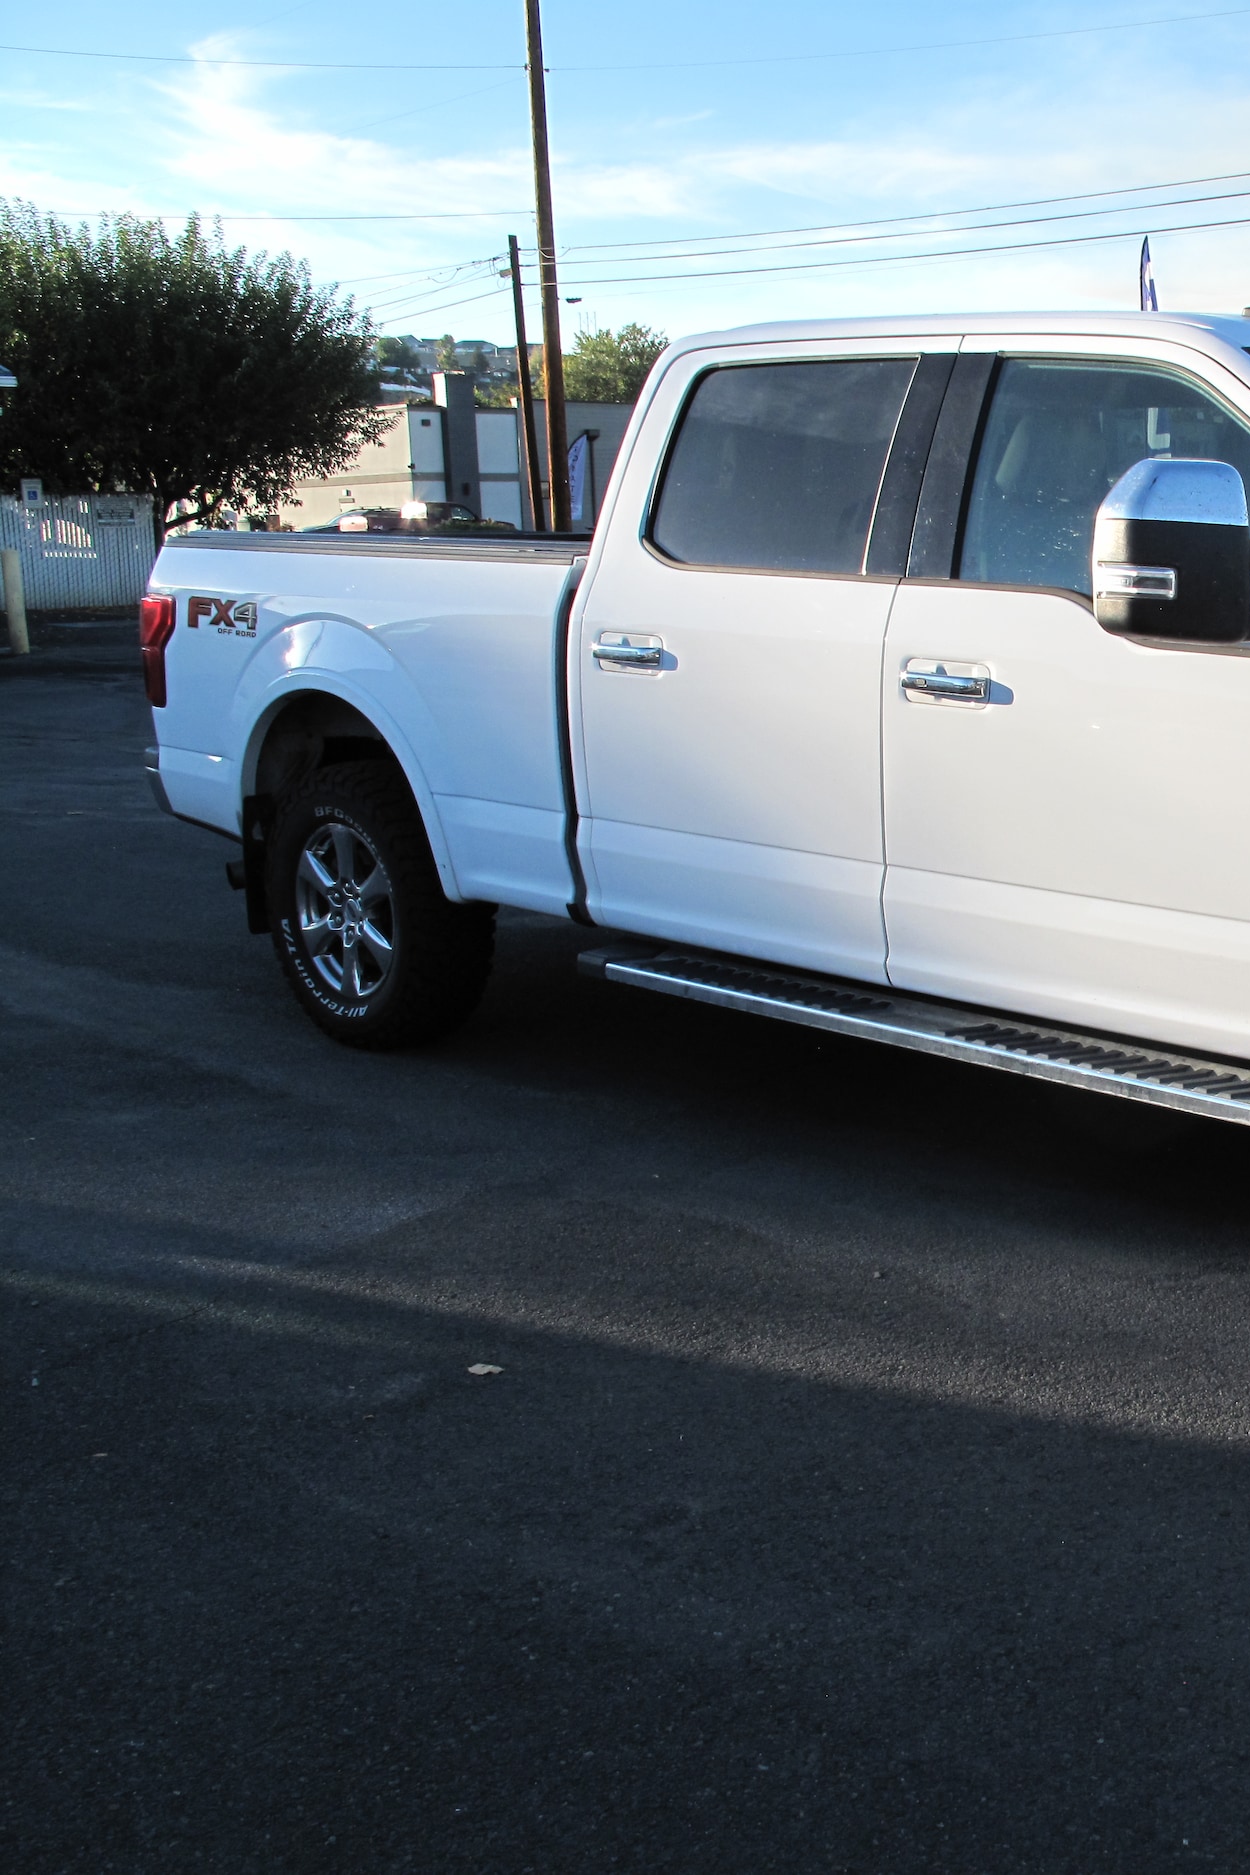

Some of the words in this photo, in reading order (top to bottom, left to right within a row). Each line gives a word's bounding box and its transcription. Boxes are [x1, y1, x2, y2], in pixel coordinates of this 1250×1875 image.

[187, 595, 258, 631] FX4
[217, 627, 233, 636] OFF
[235, 630, 257, 638] ROAD
